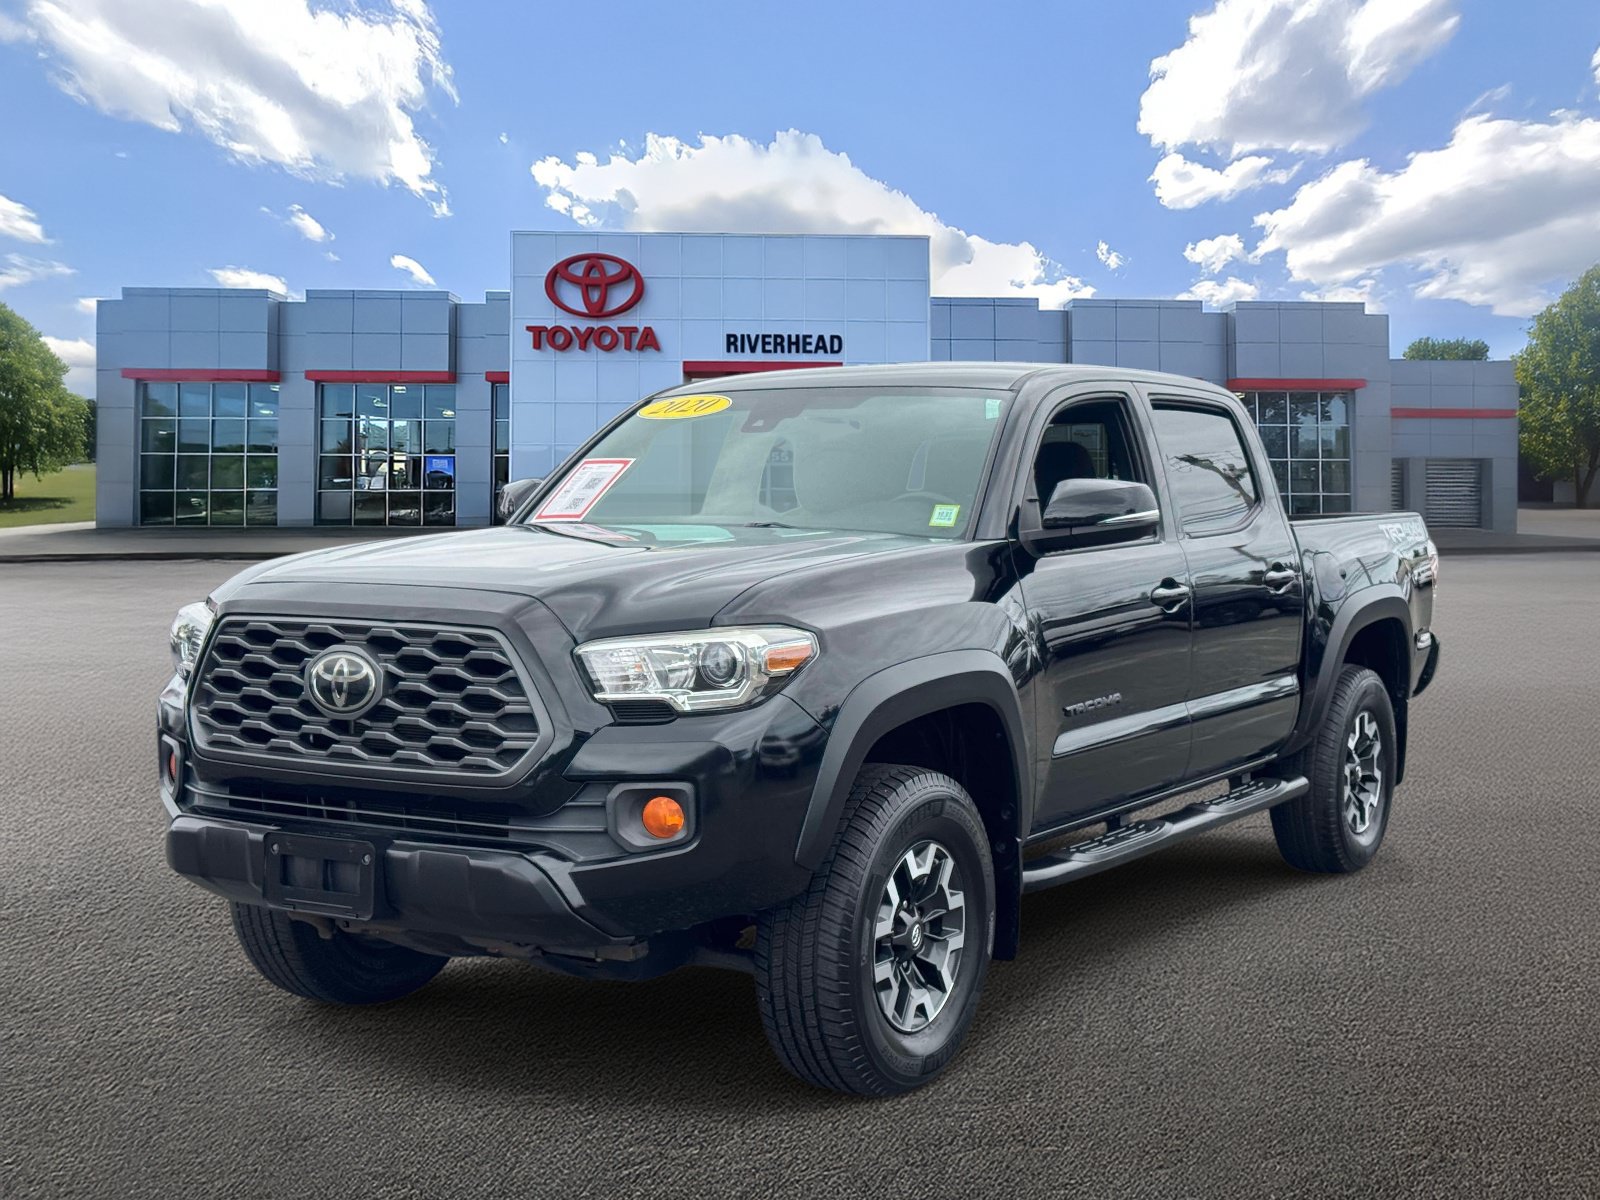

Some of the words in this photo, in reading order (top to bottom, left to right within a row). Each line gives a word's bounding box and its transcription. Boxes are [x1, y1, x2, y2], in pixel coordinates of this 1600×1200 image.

[527, 326, 660, 351] TOYOTA
[725, 333, 843, 354] RIVERHEAD
[650, 397, 721, 414] 2020
[1378, 522, 1405, 543] TRD
[1062, 692, 1122, 717] TACOMA
